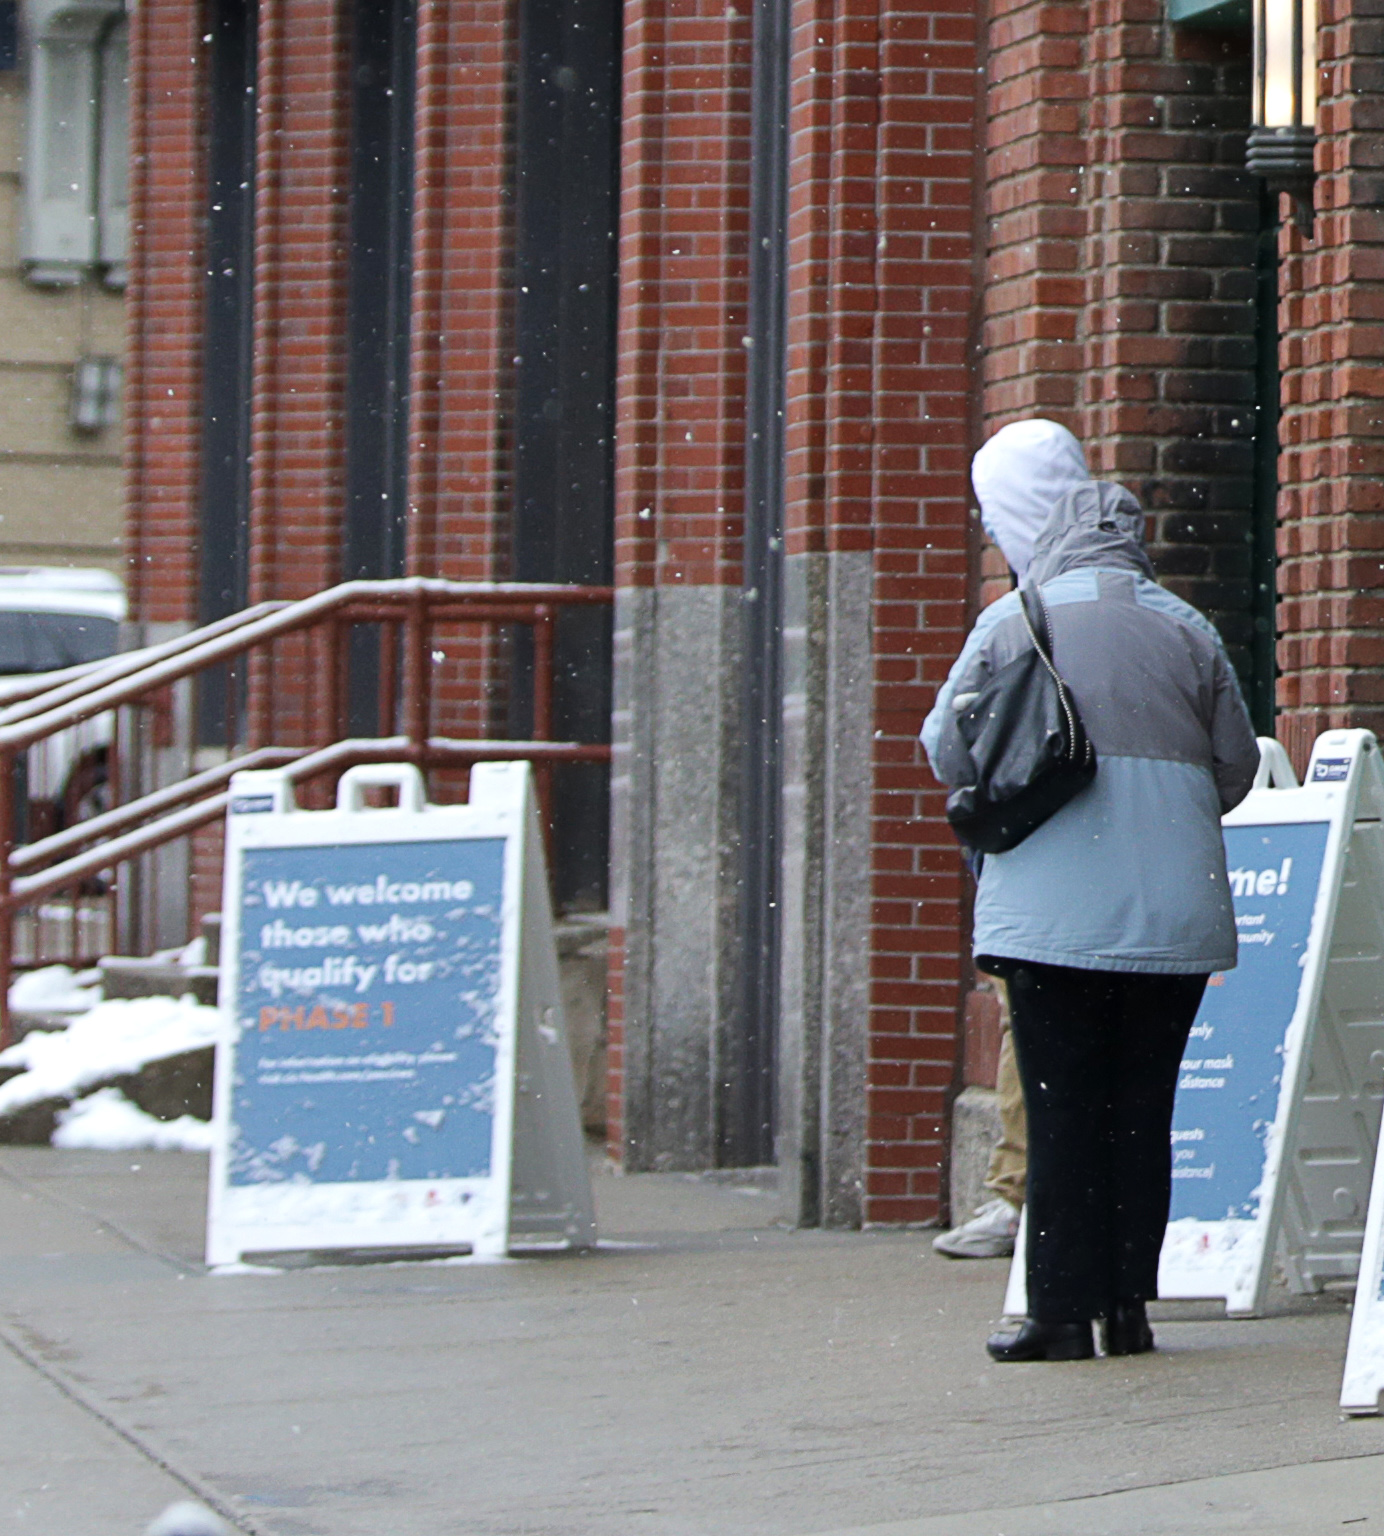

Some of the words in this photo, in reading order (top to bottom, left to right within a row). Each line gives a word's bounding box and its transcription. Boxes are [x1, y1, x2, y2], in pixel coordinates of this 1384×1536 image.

[262, 880, 318, 909] We
[325, 874, 474, 906] welcome
[260, 919, 351, 948] those
[357, 913, 434, 943] who
[259, 955, 378, 998] qualify
[383, 953, 434, 984] for
[259, 1001, 369, 1032] PHASE
[380, 1000, 395, 1028] 1
[1203, 1054, 1234, 1069] mask
[1179, 1074, 1225, 1089] distance
